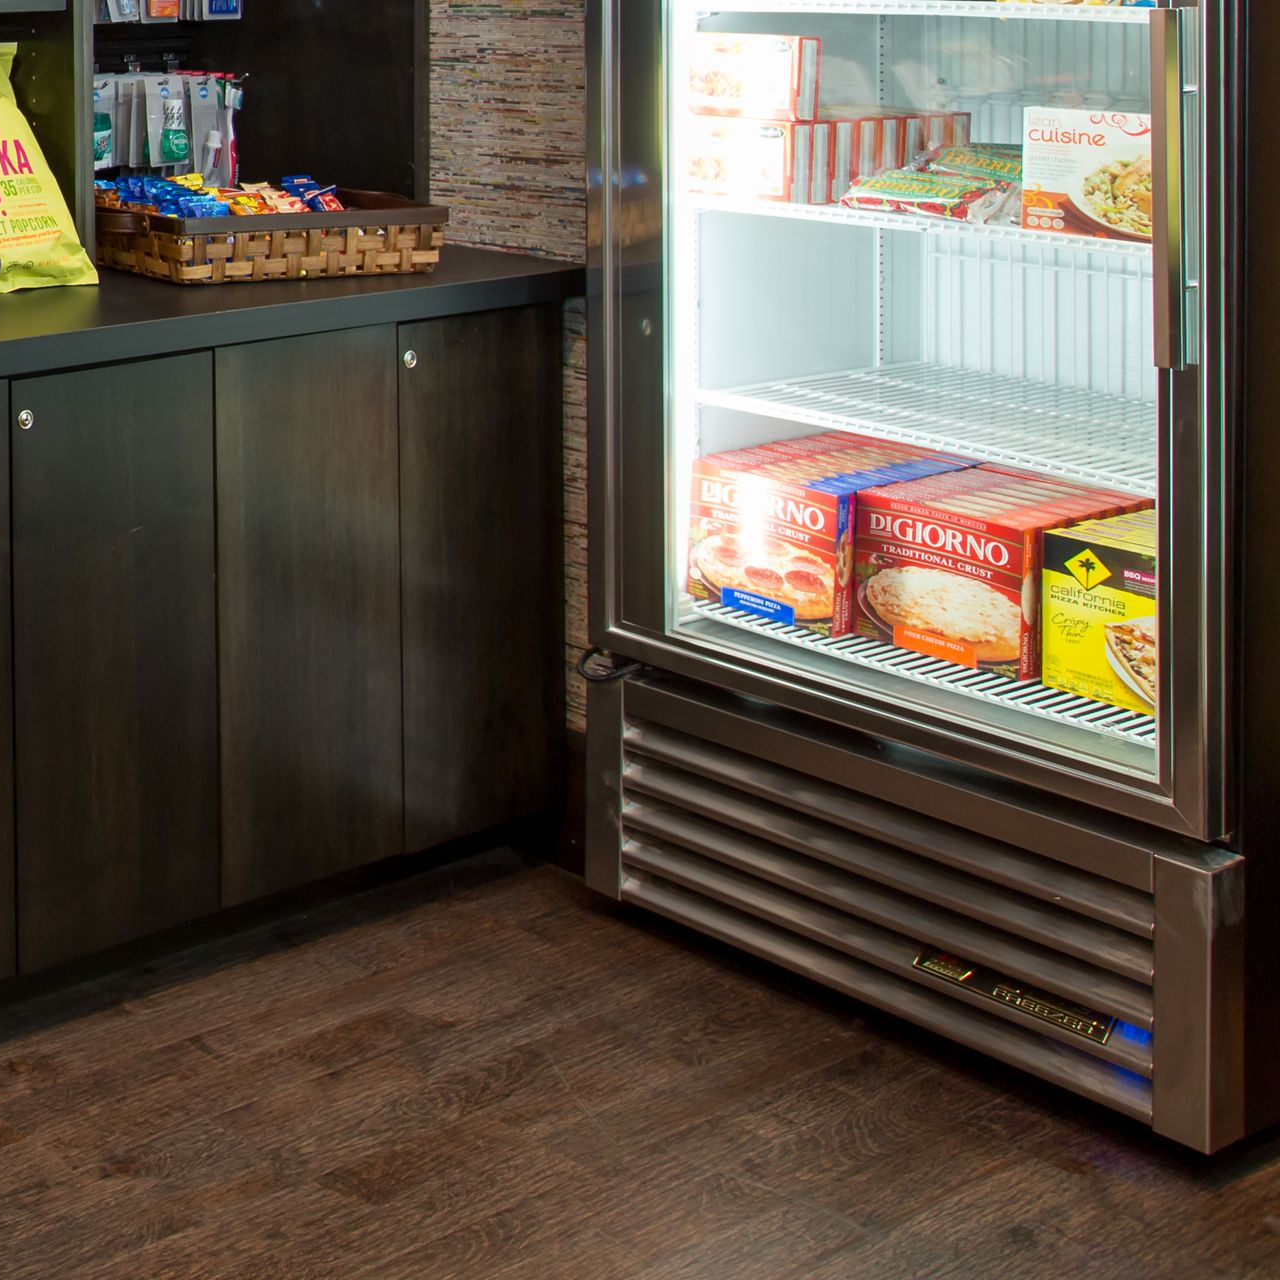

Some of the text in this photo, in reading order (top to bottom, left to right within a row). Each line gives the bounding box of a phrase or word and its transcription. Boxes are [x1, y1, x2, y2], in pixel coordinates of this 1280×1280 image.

[1028, 128, 1106, 146] cuisine
[10, 216, 58, 234] POPCORN
[881, 544, 993, 579] TRADITIONAL CRUST
[1050, 585, 1126, 610] california
[1050, 594, 1126, 616] PIZZA KITCHEN
[903, 629, 965, 652] FOUR CHEESE PIZZA
